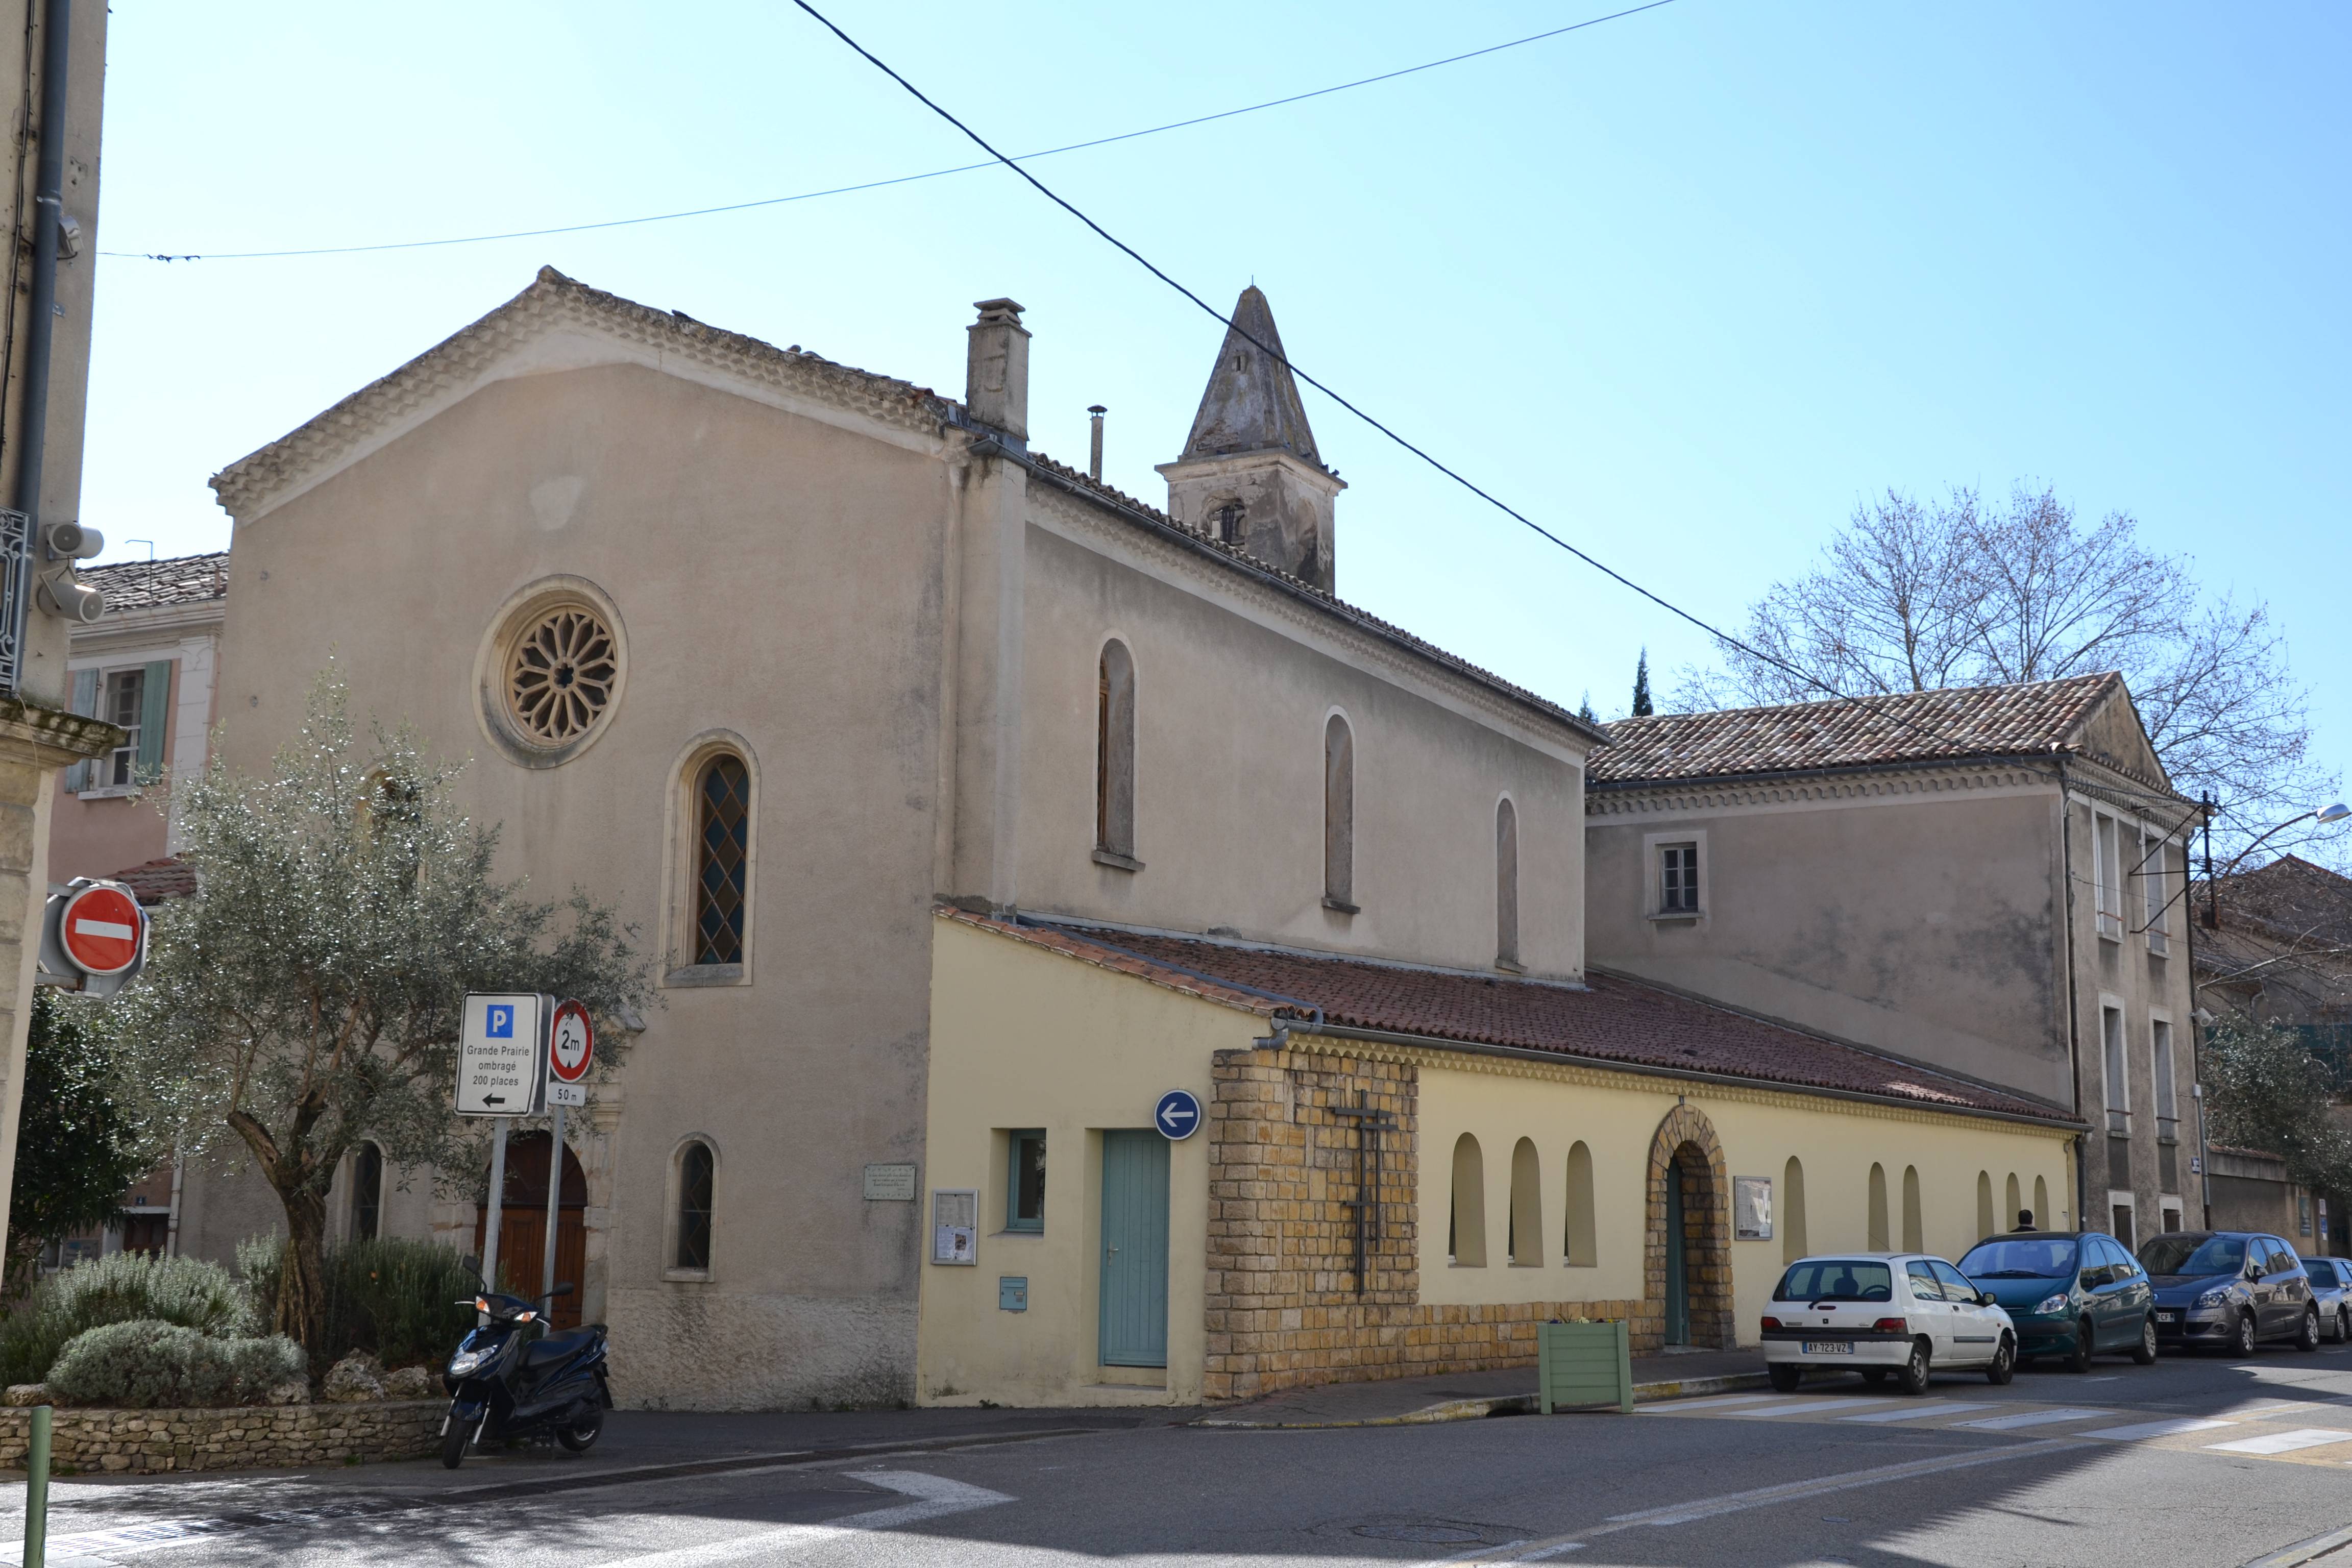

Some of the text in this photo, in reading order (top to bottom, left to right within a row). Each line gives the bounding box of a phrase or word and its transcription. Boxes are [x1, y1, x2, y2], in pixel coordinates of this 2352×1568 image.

[493, 1010, 506, 1033] P
[467, 1045, 529, 1056] Grande Prairie
[478, 1061, 516, 1073] ombragé
[473, 1075, 519, 1087] 200 places
